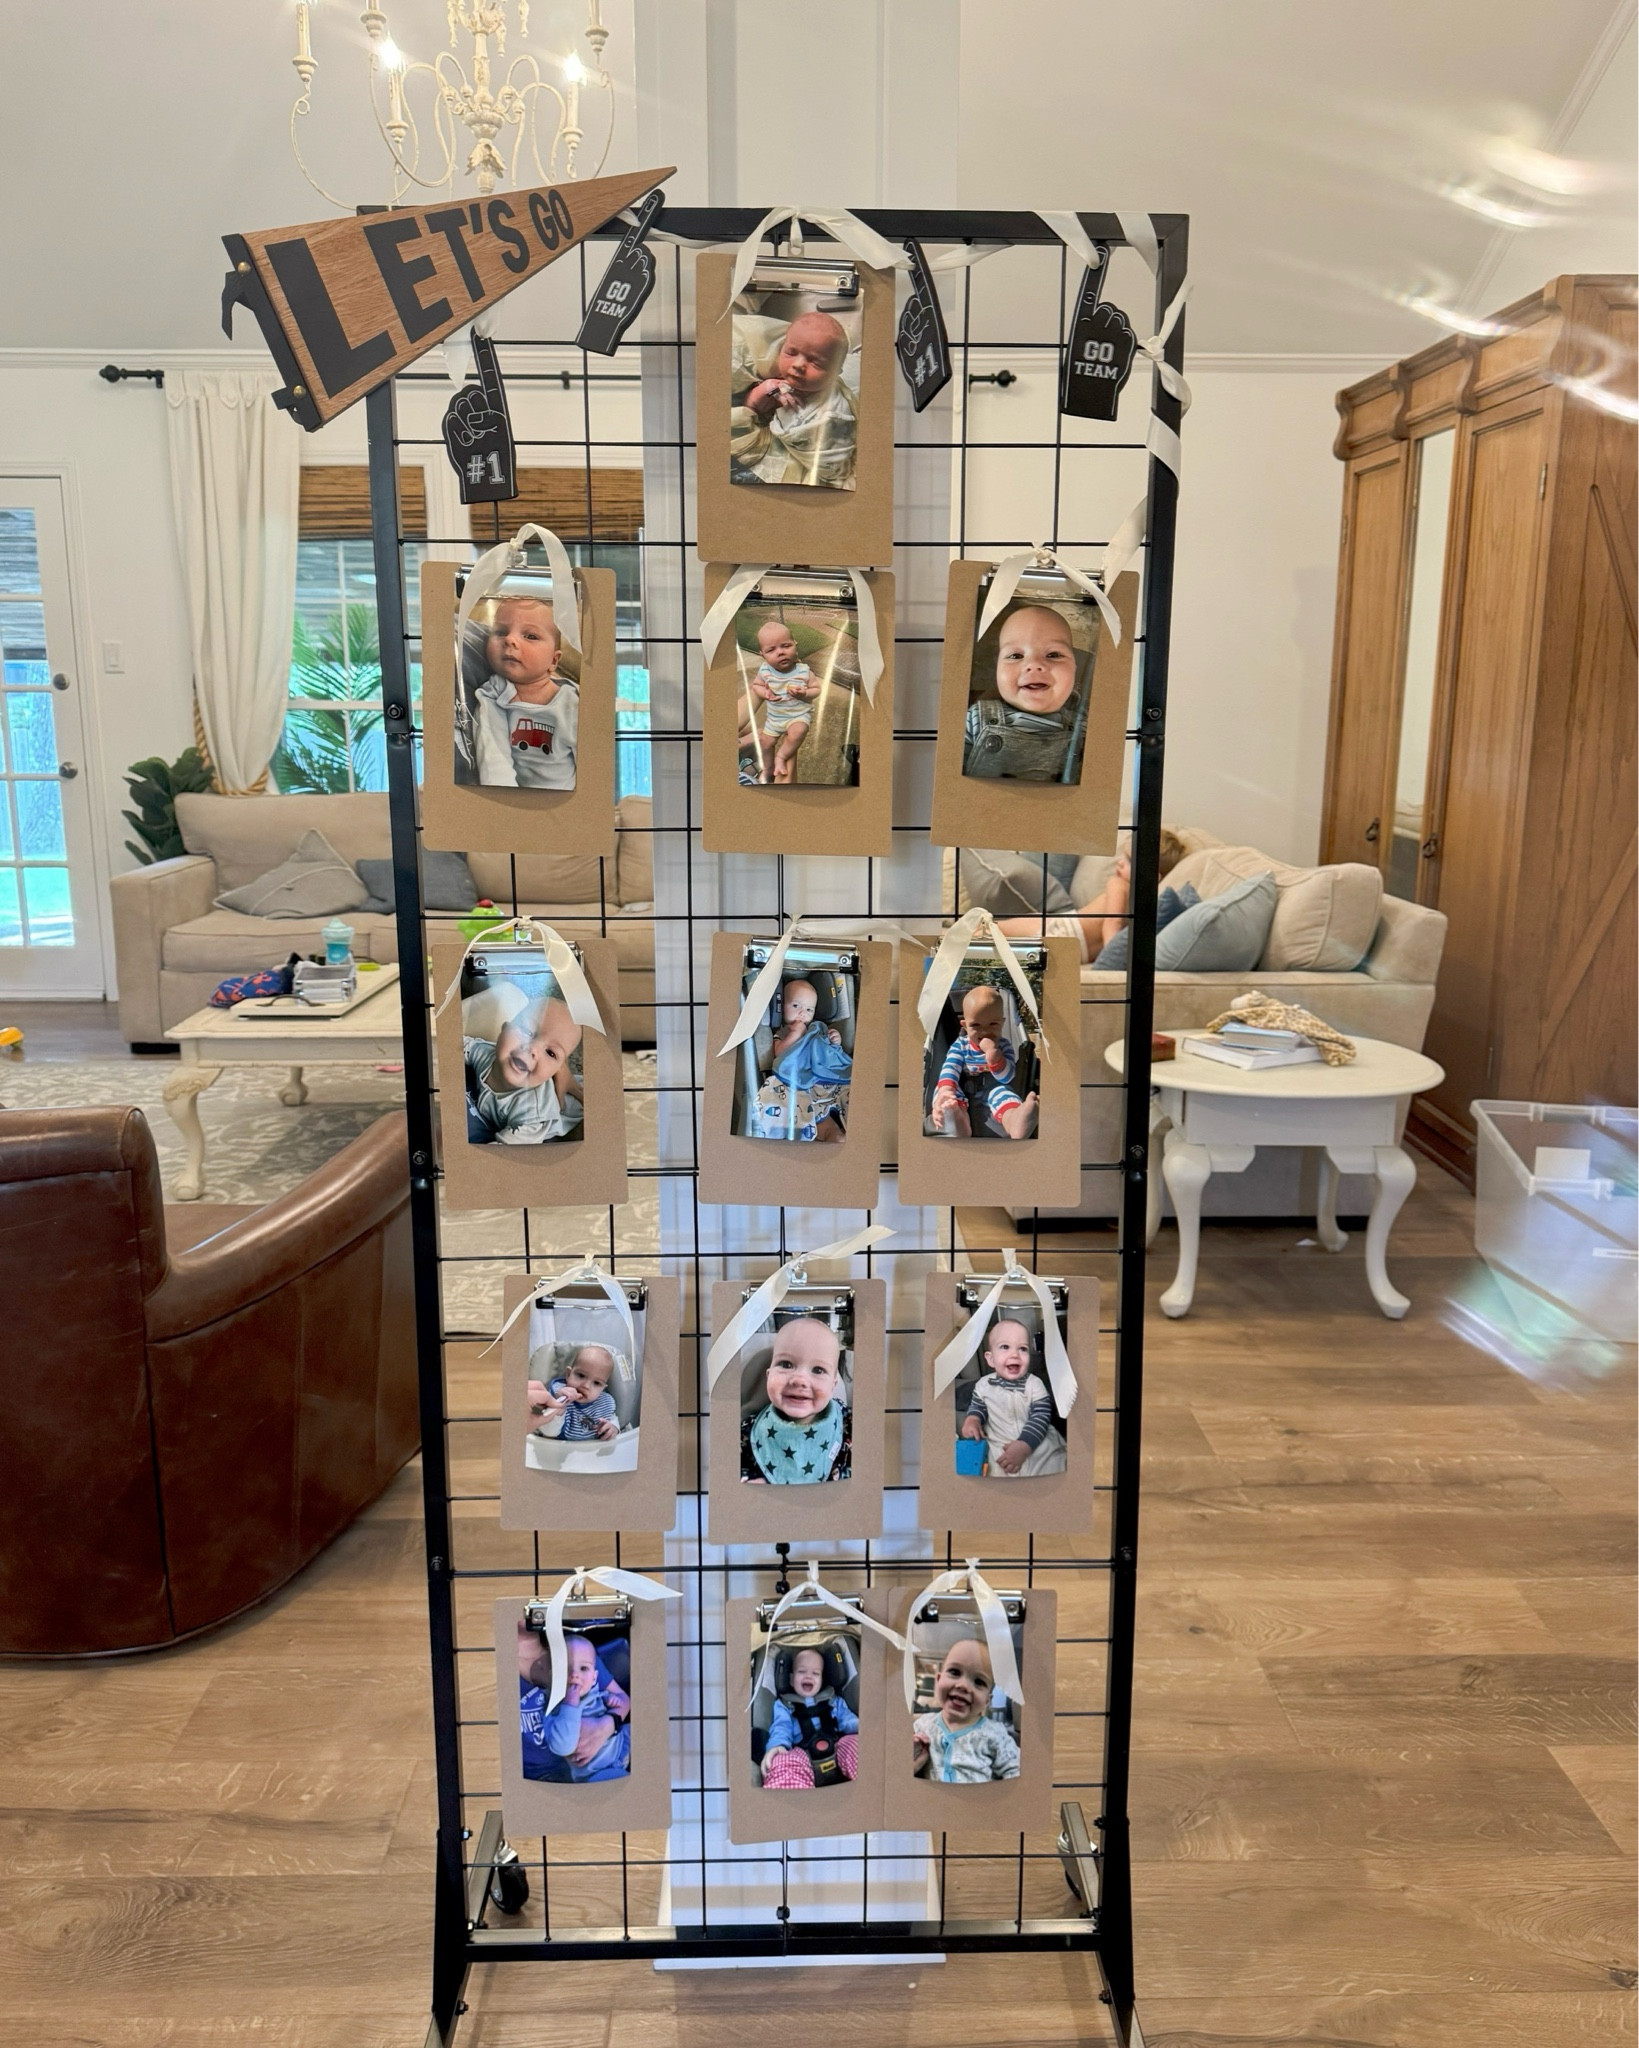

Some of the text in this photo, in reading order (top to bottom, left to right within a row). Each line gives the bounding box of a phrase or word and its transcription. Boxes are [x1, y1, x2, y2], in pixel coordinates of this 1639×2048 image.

[264, 189, 574, 399] LET'S GO
[606, 280, 631, 302] GO
[595, 300, 627, 318] TEAM
[1083, 340, 1115, 363] GO
[914, 342, 939, 387] #1
[1074, 361, 1119, 380] TEAM
[466, 450, 506, 484] #1
